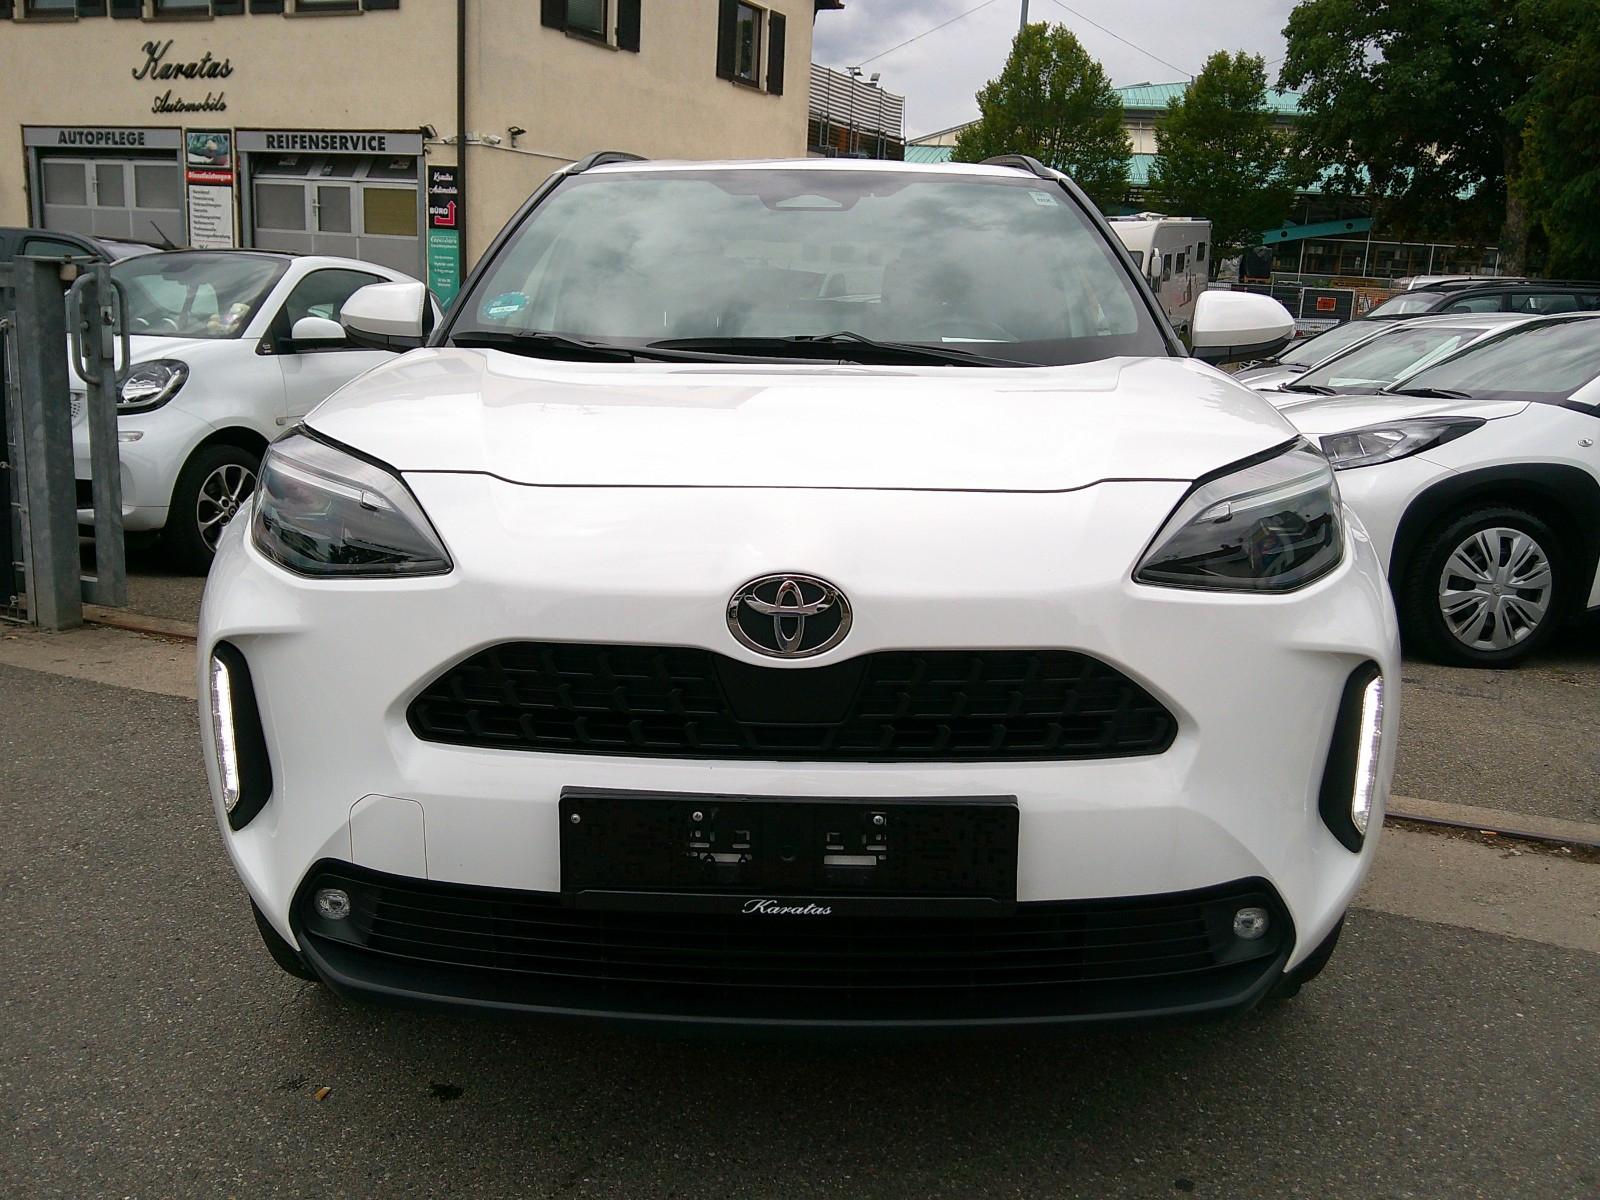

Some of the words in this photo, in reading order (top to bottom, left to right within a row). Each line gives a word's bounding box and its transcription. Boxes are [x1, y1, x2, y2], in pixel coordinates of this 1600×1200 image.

[131, 39, 234, 80] Karatas
[58, 130, 145, 146] AUTOPFLEGE
[266, 134, 386, 151] REIFENSERVICE
[429, 206, 449, 215] BÜRO
[741, 899, 832, 915] Karatas
